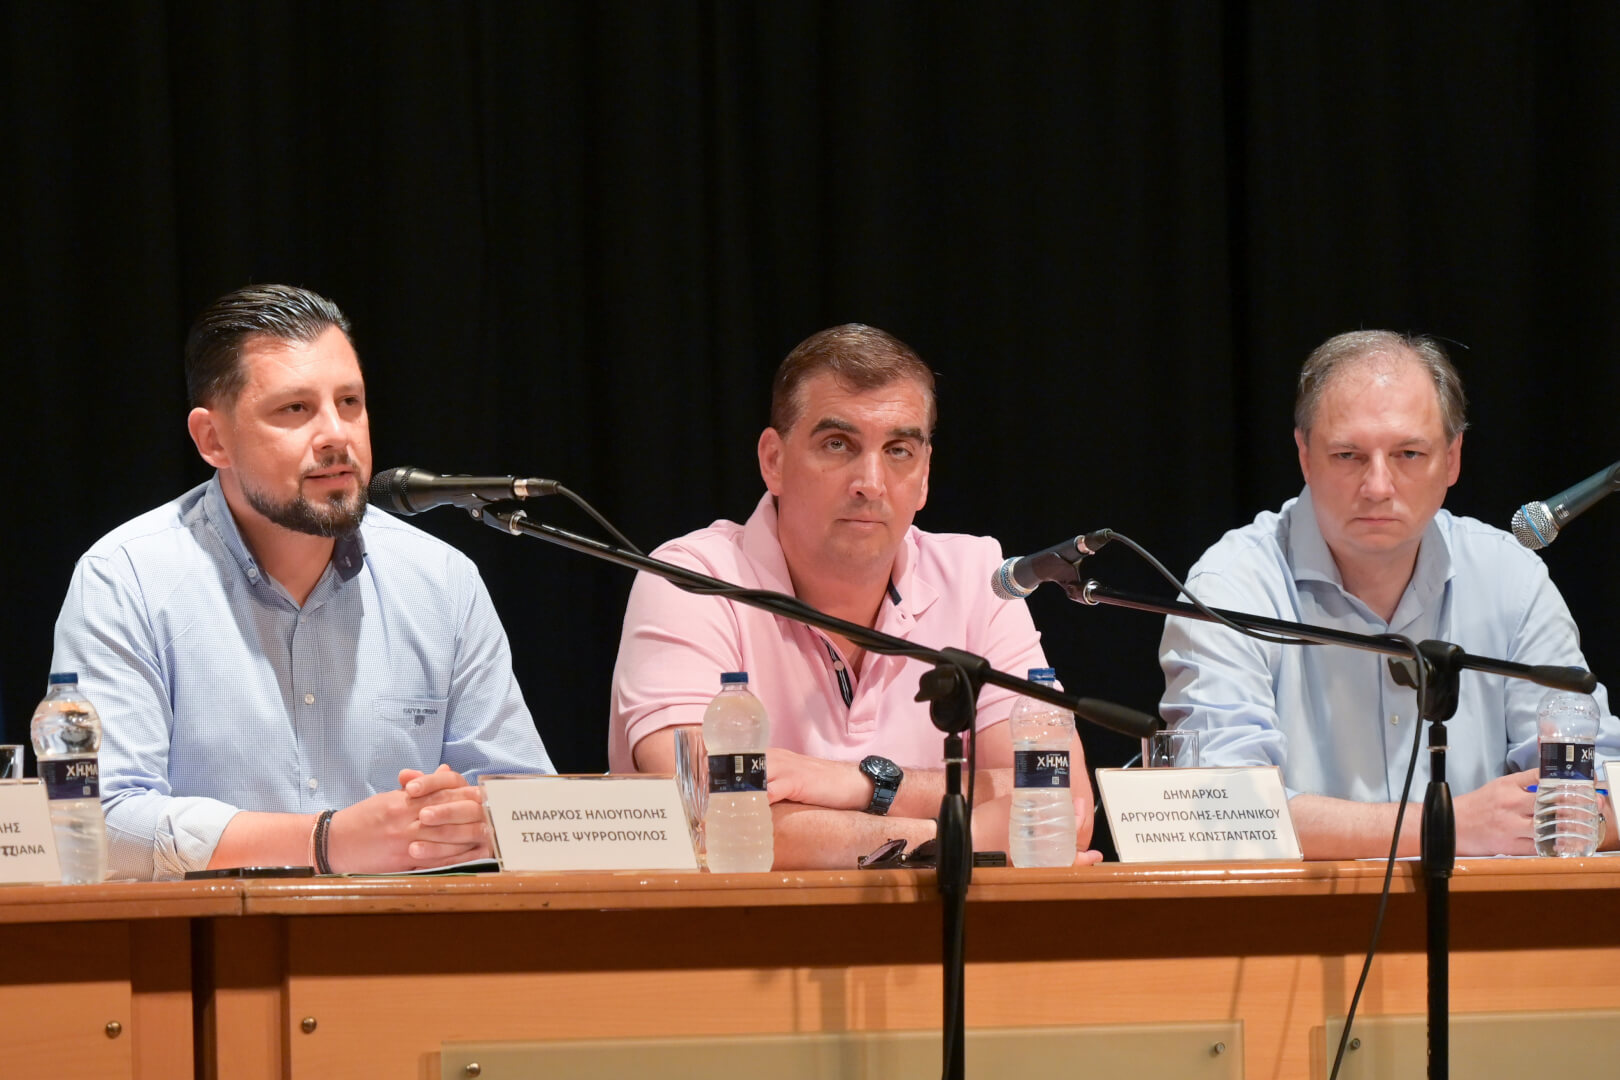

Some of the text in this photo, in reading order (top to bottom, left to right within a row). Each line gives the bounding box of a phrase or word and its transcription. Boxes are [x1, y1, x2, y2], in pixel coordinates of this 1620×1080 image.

[1163, 789, 1229, 800] ΔΗΜΑΡΧΟΣ
[511, 808, 668, 821] ΔΗΜΑΡΧΟΣ ΗΛΙΟΥΠΟΛΗΣ
[1121, 808, 1280, 823] ΑΡΓΥΡΟΥΠΟΛΗΣ-ΕΛΛΗΝΙΚΟΥ
[521, 830, 668, 843] ΣΤΑΘΗΣ ΨΥΡΡΟΠΟΥΛΟΣ
[1135, 830, 1278, 843] ΓΙΑΝΝΗΣ ΚΩΝΣΤΑΝΤΑΤΟΣ
